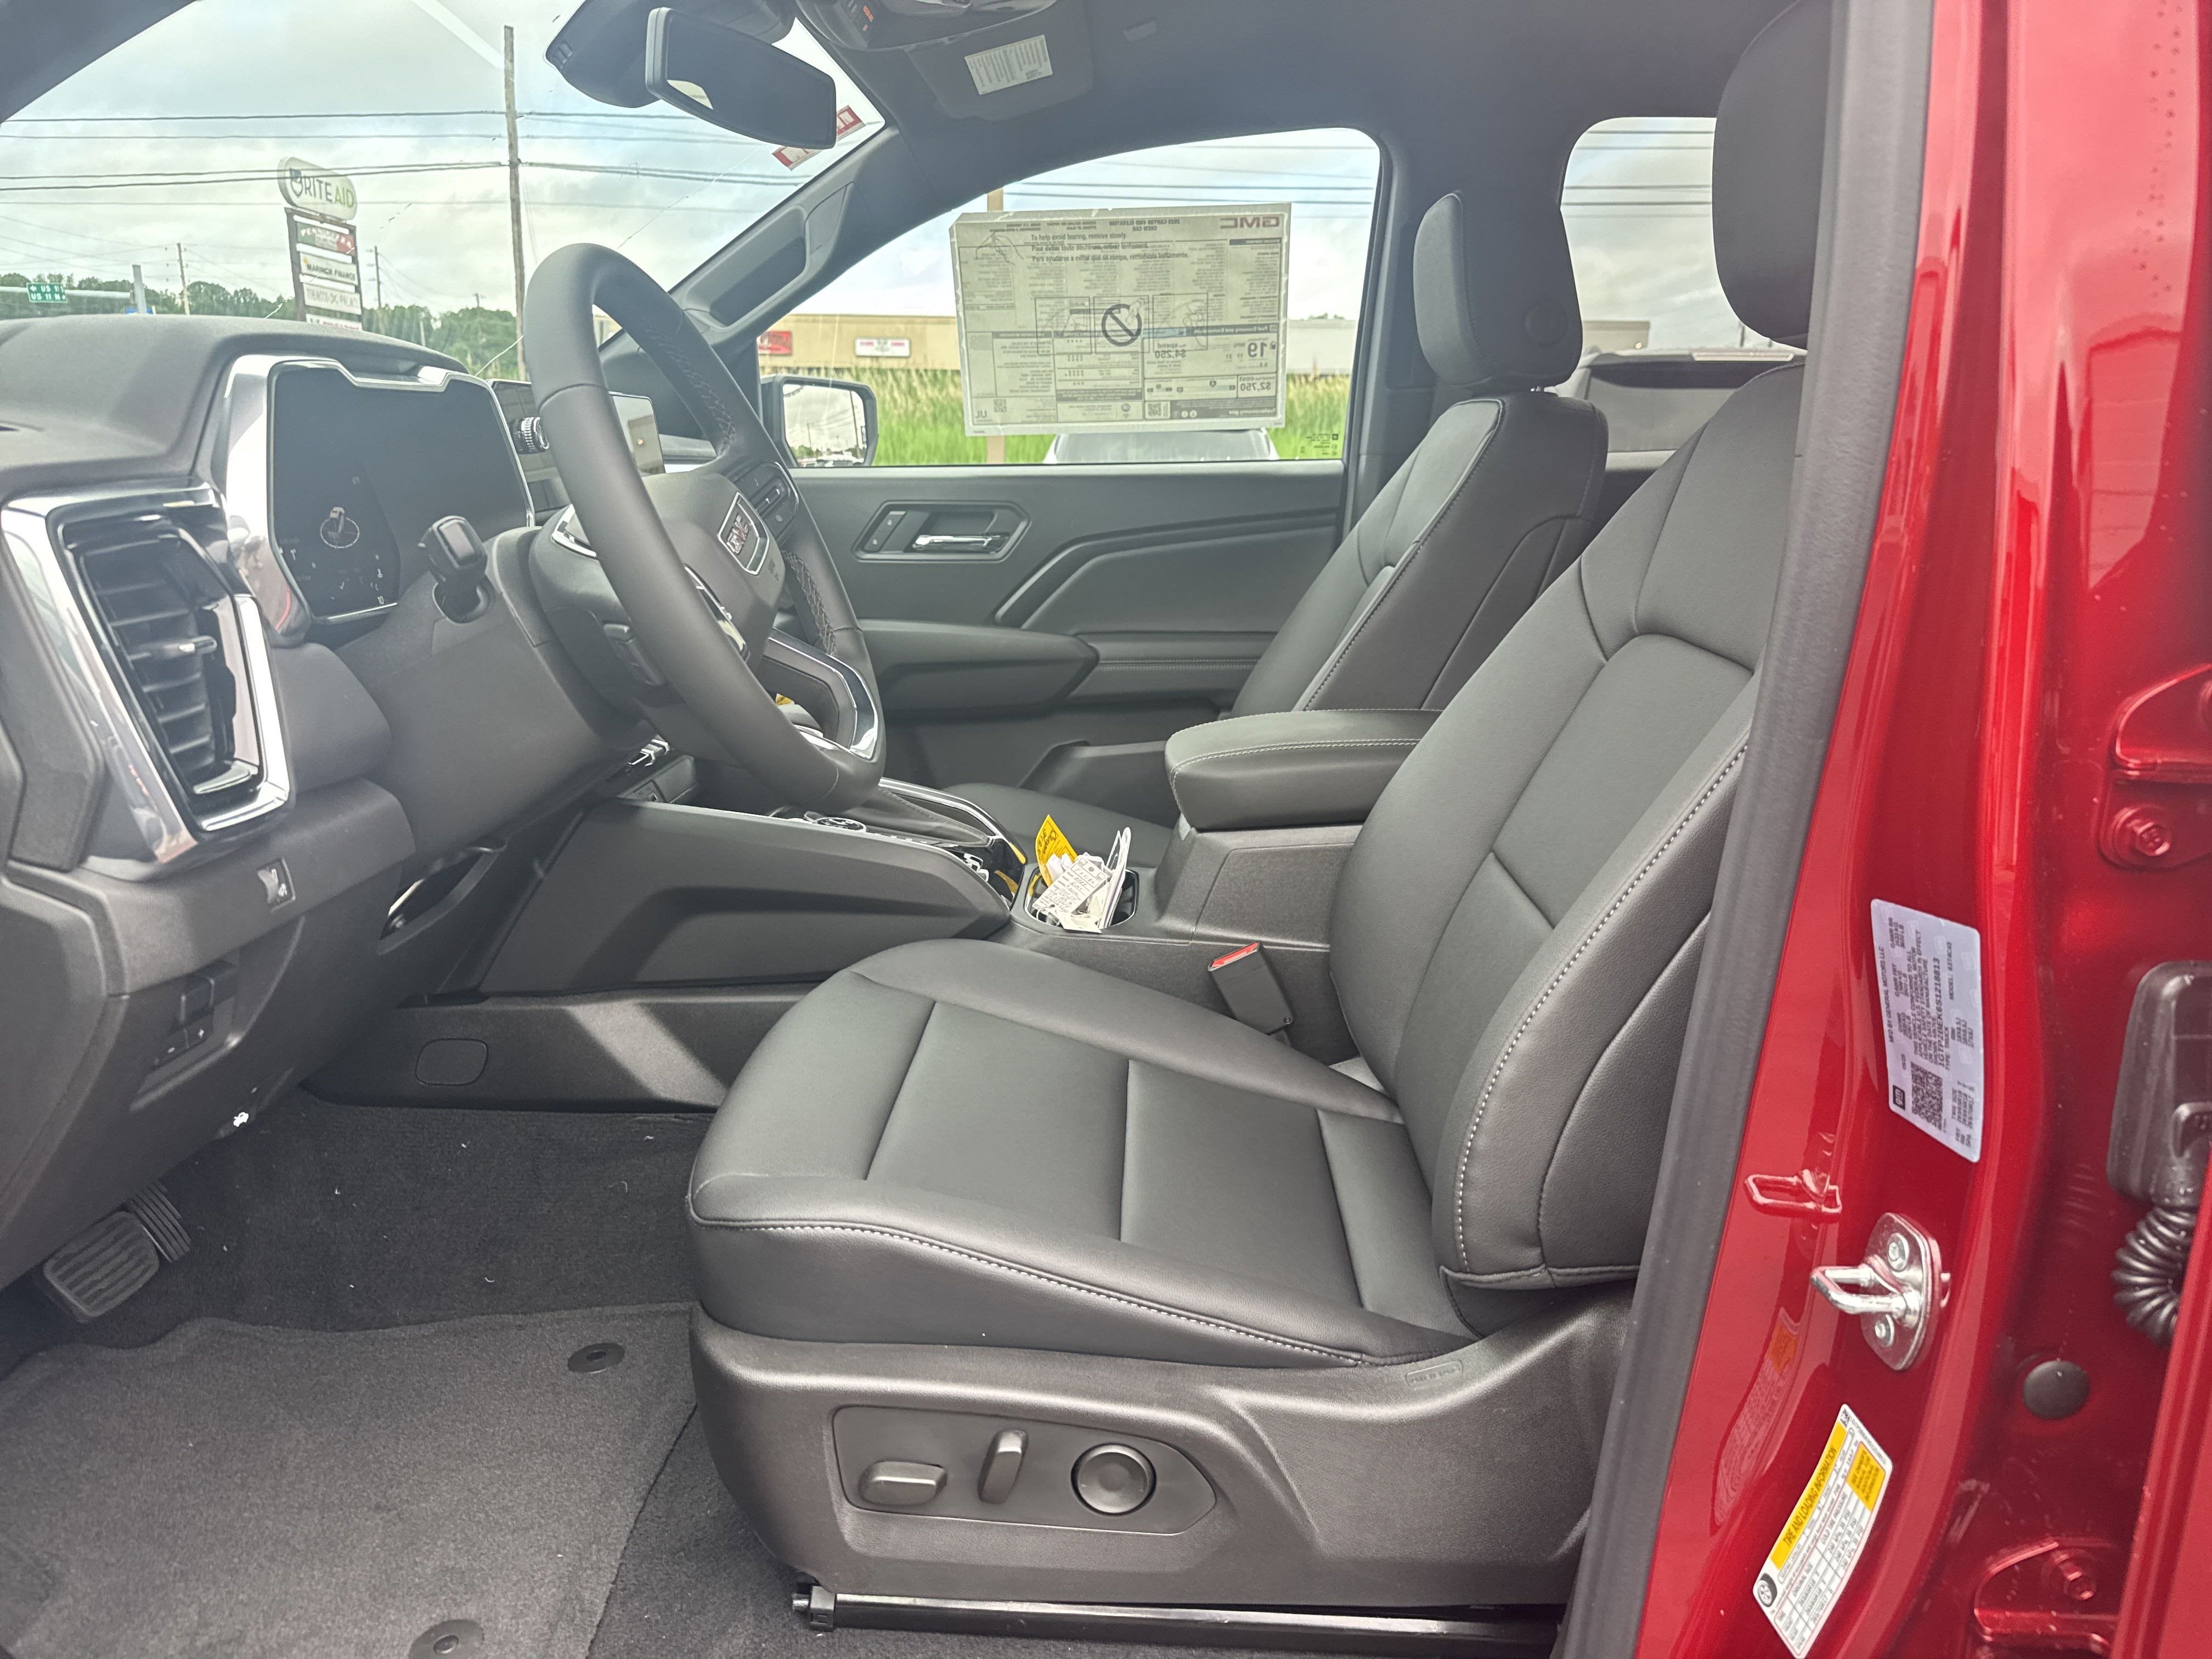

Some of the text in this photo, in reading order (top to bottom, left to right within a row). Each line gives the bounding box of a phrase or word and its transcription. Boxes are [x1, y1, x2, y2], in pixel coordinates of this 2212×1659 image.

[304, 176, 354, 208] RITE AID
[726, 514, 748, 554] GMC
[1888, 917, 1893, 927] RR
[1907, 962, 1912, 973] TO
[1925, 1008, 1931, 1019] OF
[1887, 1018, 1892, 1029] BY
[1928, 1052, 1933, 1064] ON
[1894, 1087, 1904, 1107] gm
[1782, 1443, 1837, 1548] TIRE AND LOADING INFORMATION
